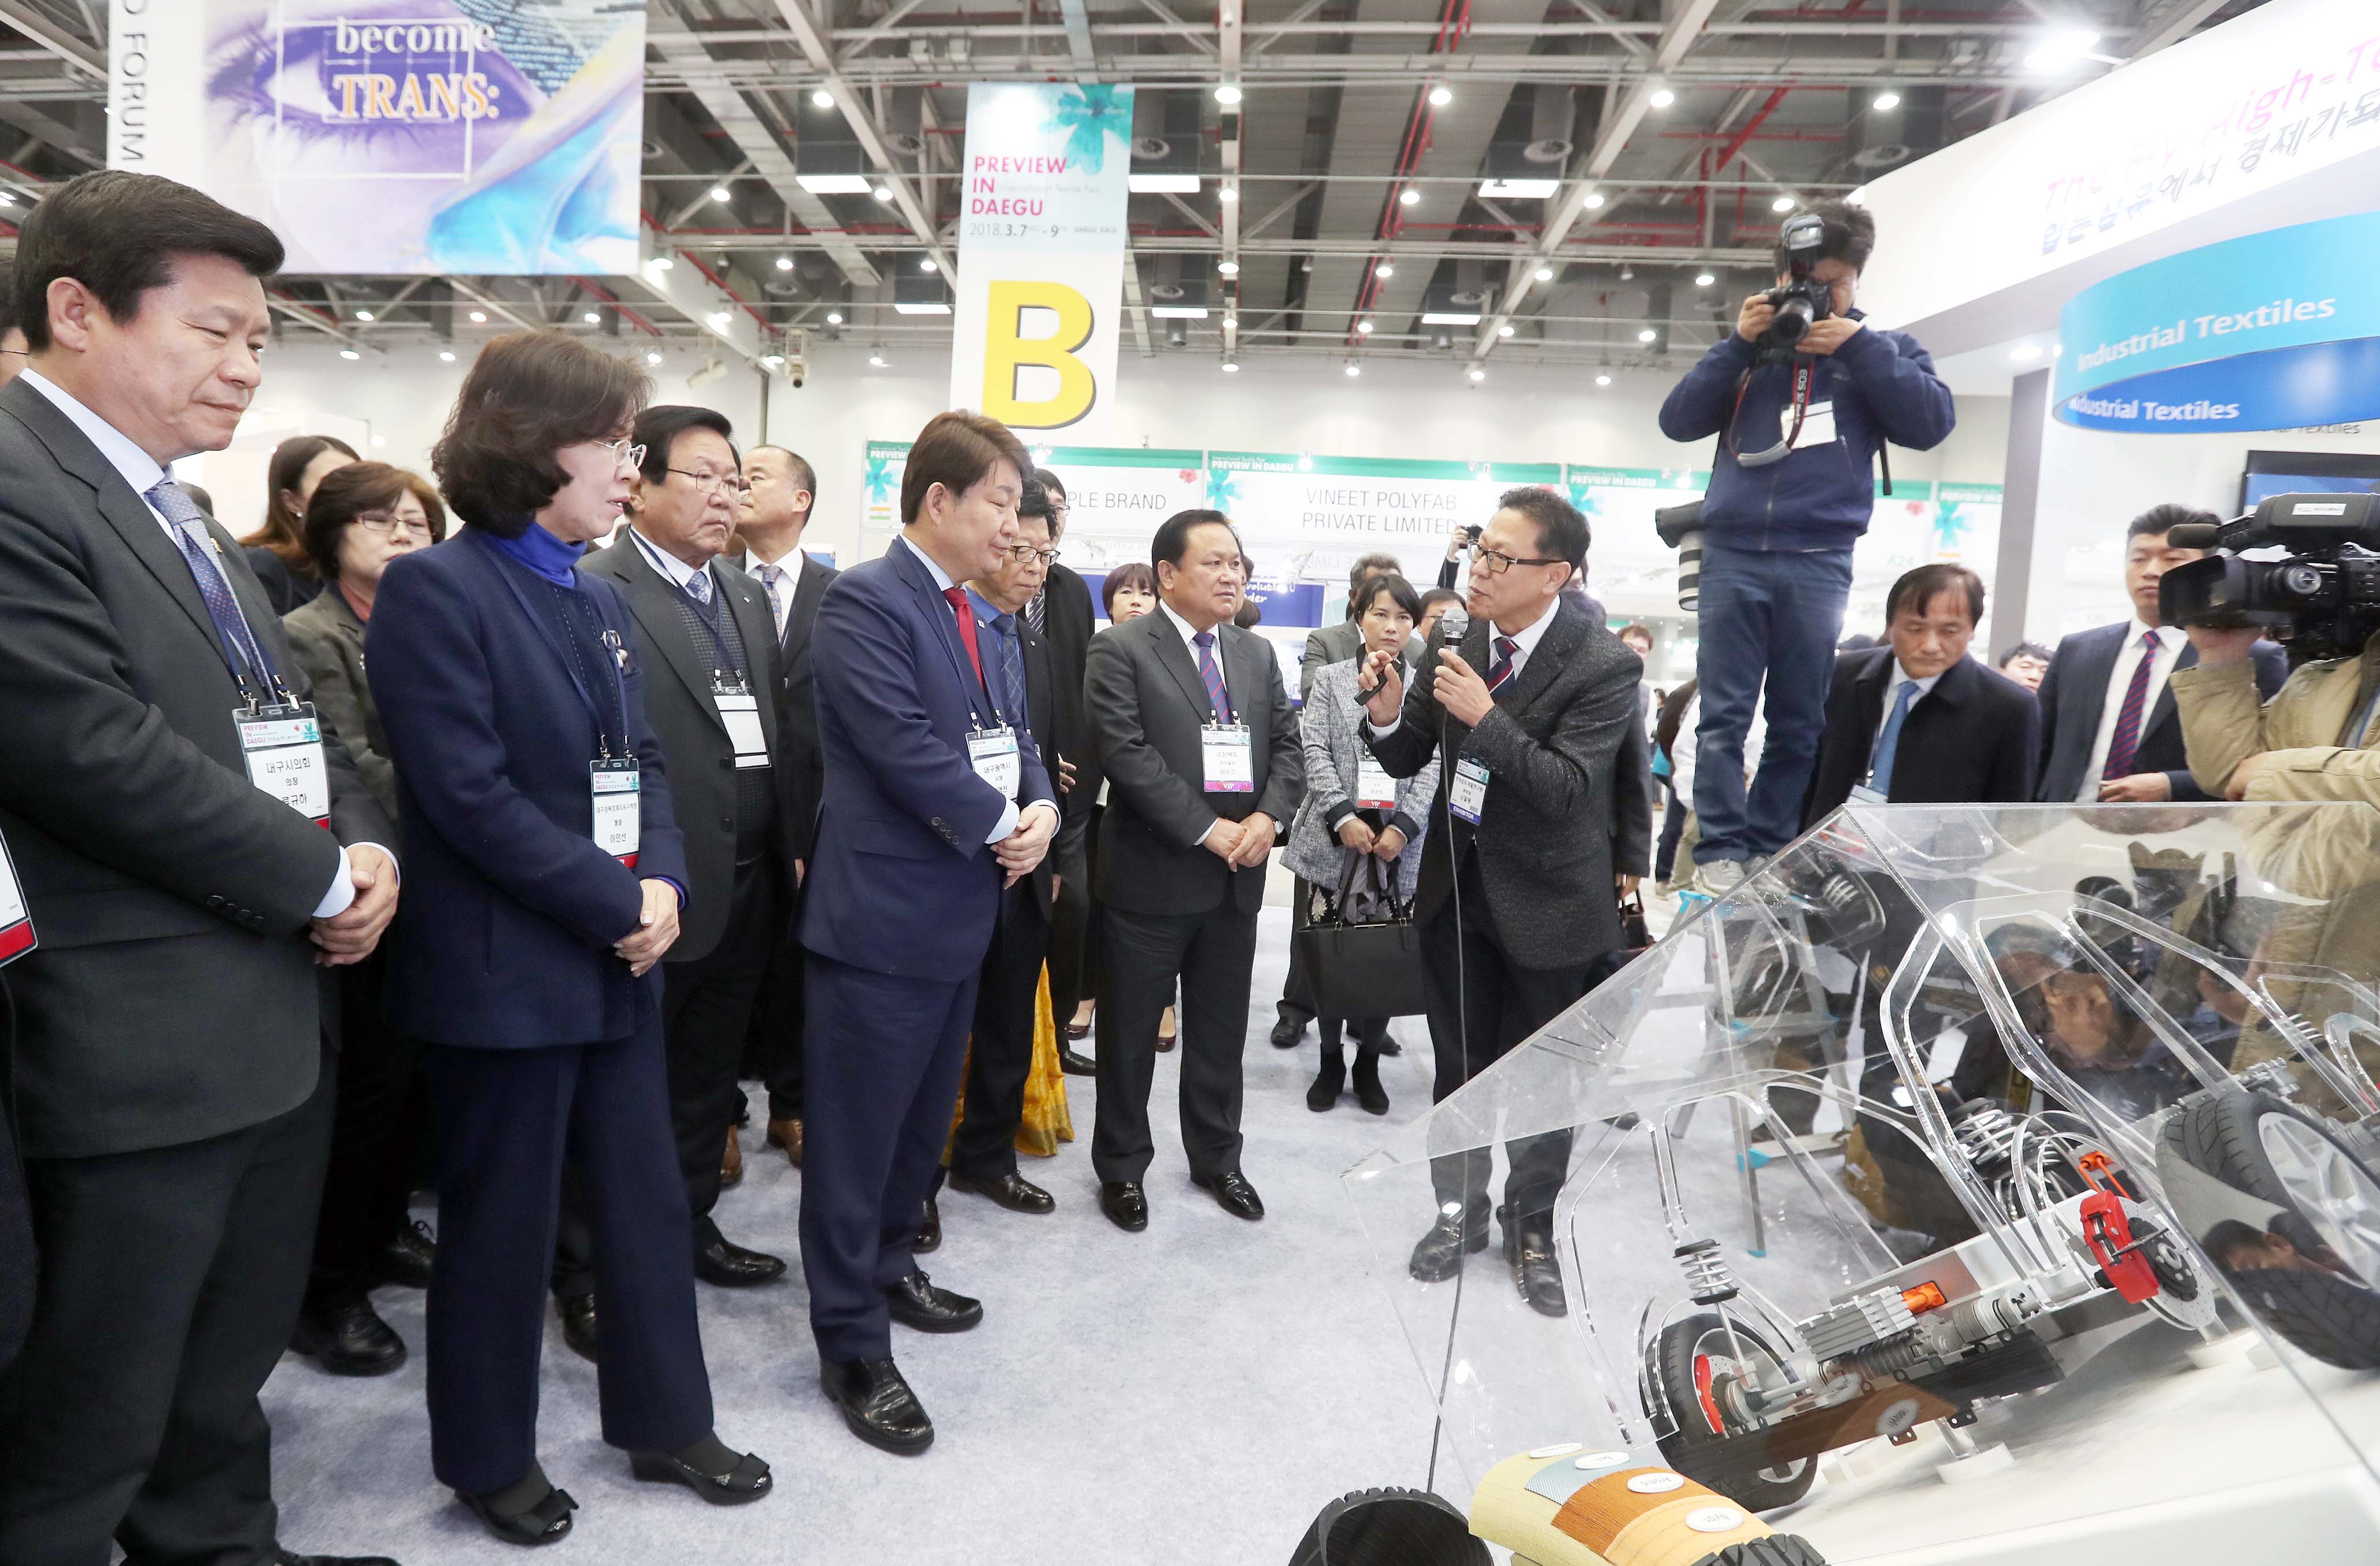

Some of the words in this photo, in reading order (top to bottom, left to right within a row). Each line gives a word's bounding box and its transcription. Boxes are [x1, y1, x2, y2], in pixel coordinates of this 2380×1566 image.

[336, 16, 496, 54] become
[121, 33, 147, 161] FORUM
[332, 72, 501, 120] TRANS:
[974, 156, 1067, 173] PREVIEW
[973, 177, 995, 193] IN
[971, 198, 1043, 216] DAEGU
[2077, 319, 2187, 374] Industrial
[2194, 297, 2337, 339] Textiles
[981, 279, 1096, 430] B
[2141, 400, 2240, 421] Textiles
[870, 450, 908, 459] PREVIEW
[1211, 460, 1251, 470] PREVIEW
[1252, 461, 1263, 470] IN
[1263, 462, 1294, 472] DAEGU
[1570, 474, 1612, 485] PREVIEW
[1612, 476, 1624, 485] IN
[1067, 492, 1098, 508] PLE
[1105, 493, 1167, 510] BRAND
[1306, 488, 1370, 507] VINEET
[1377, 492, 1457, 511] POLYFAB
[1302, 512, 1377, 531] PRIVATE
[1384, 516, 1458, 534] LIMITED
[243, 723, 268, 732] PREVIEW
[266, 757, 311, 774] 대구시의회
[984, 762, 1011, 774] 대구광역시
[1453, 805, 1475, 821] EXHIBITOR
